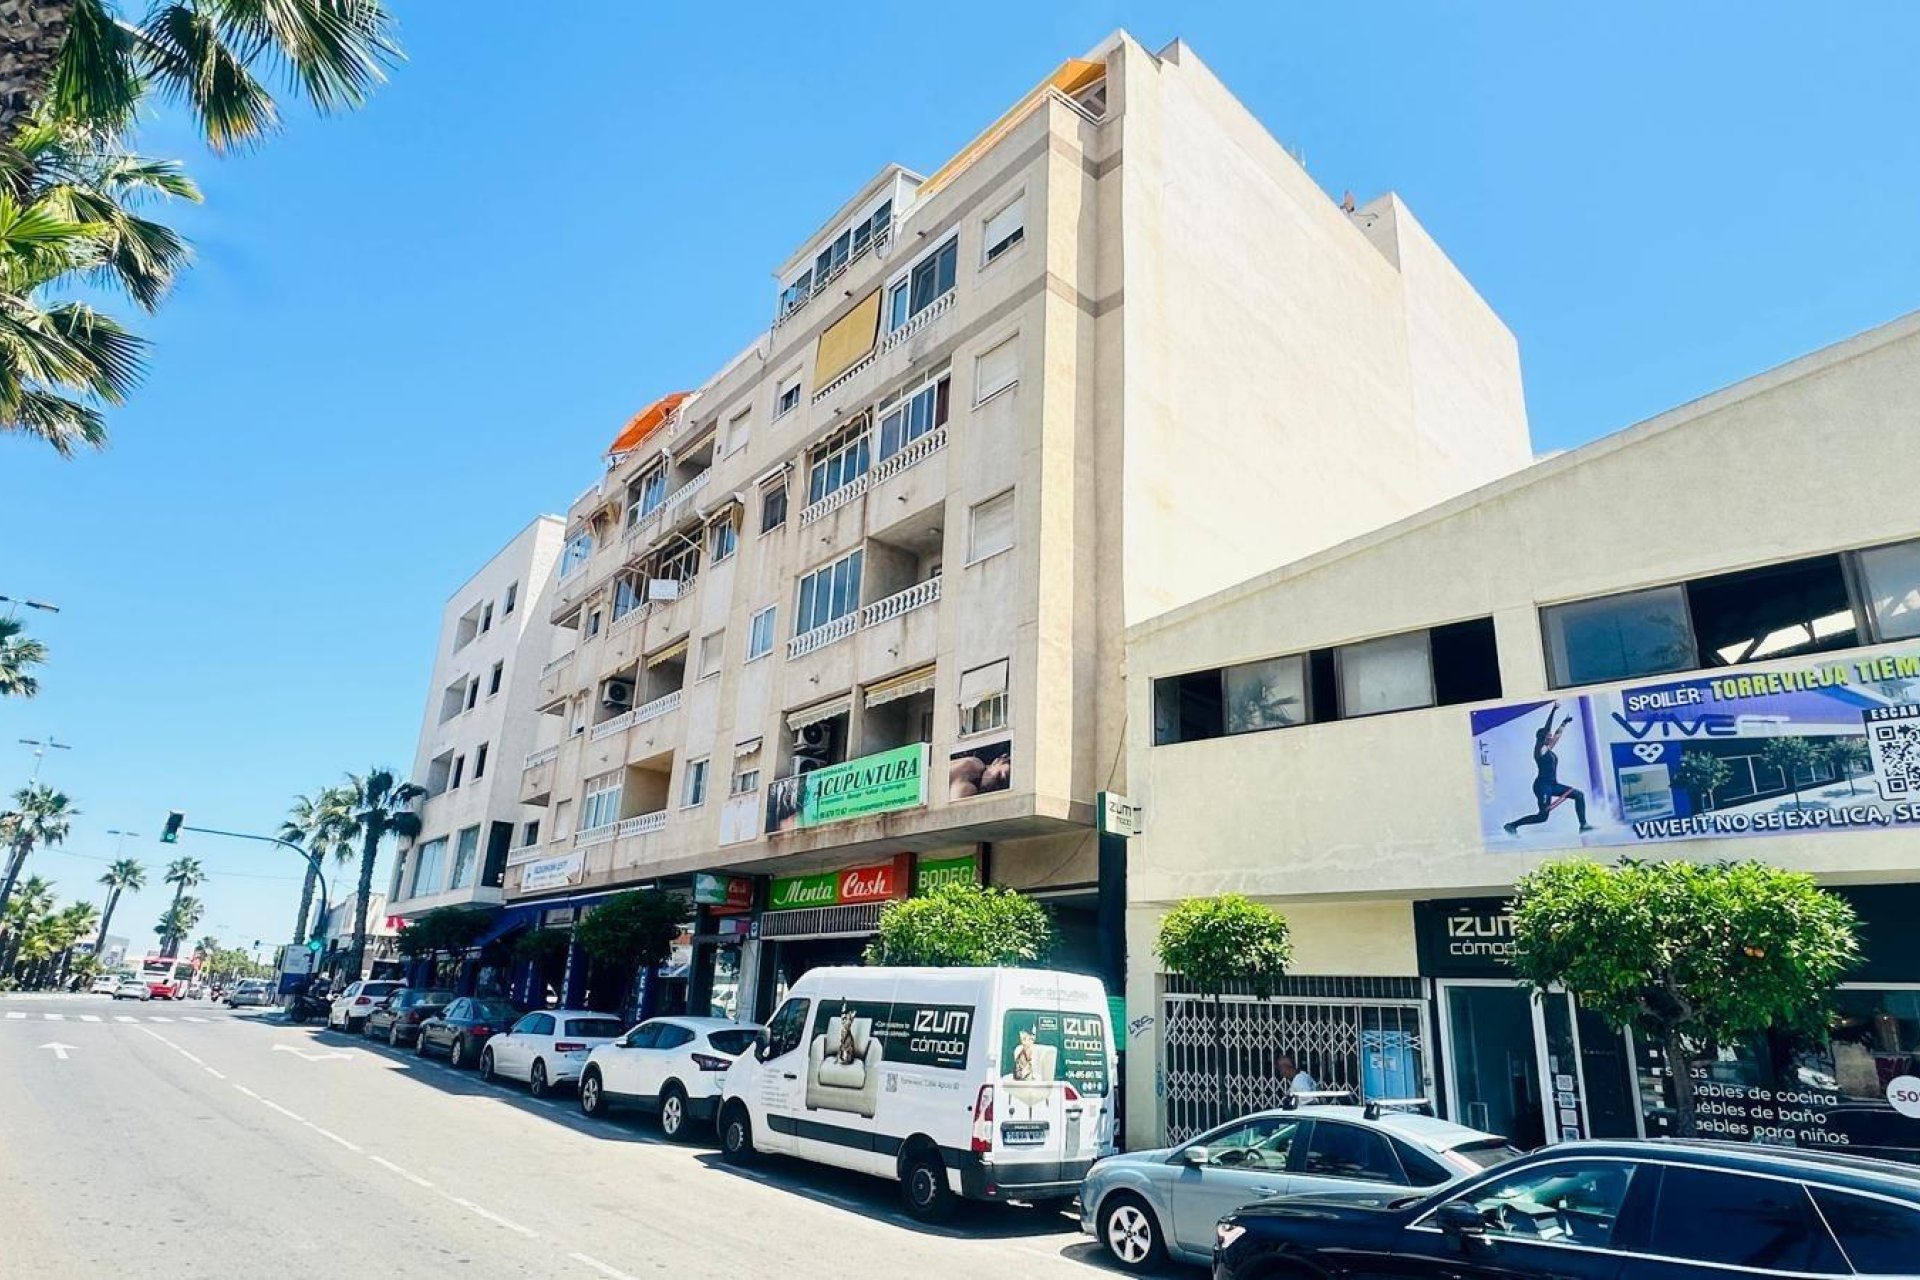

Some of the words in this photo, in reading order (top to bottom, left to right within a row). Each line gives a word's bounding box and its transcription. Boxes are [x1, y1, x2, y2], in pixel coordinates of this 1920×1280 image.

[1628, 687, 1704, 712] SPOILER:
[1710, 664, 1849, 703] TORREVIEJA
[1853, 655, 1920, 684] TIEM
[814, 757, 918, 798] ACUPUNTURA
[1634, 815, 1709, 837] VIVEFIT
[1716, 813, 1749, 831] NO
[1754, 811, 1780, 829] SE
[1784, 804, 1890, 827] EXPLICA,
[773, 879, 834, 905] Menta
[841, 870, 893, 898] Cash
[913, 1009, 970, 1035] IZUM
[1063, 1017, 1102, 1037] IZUM
[910, 1035, 966, 1056] cómodo
[1692, 1083, 1744, 1099] ebles
[1747, 1086, 1772, 1101] de
[1776, 1090, 1839, 1106] cocina
[1890, 1090, 1920, 1102] -50
[1694, 1100, 1746, 1117] ebles
[1750, 1104, 1774, 1120] de
[1777, 1106, 1828, 1125] baño
[1696, 1118, 1749, 1135] ebles
[1753, 1125, 1796, 1139] para
[1800, 1127, 1850, 1145] niños
